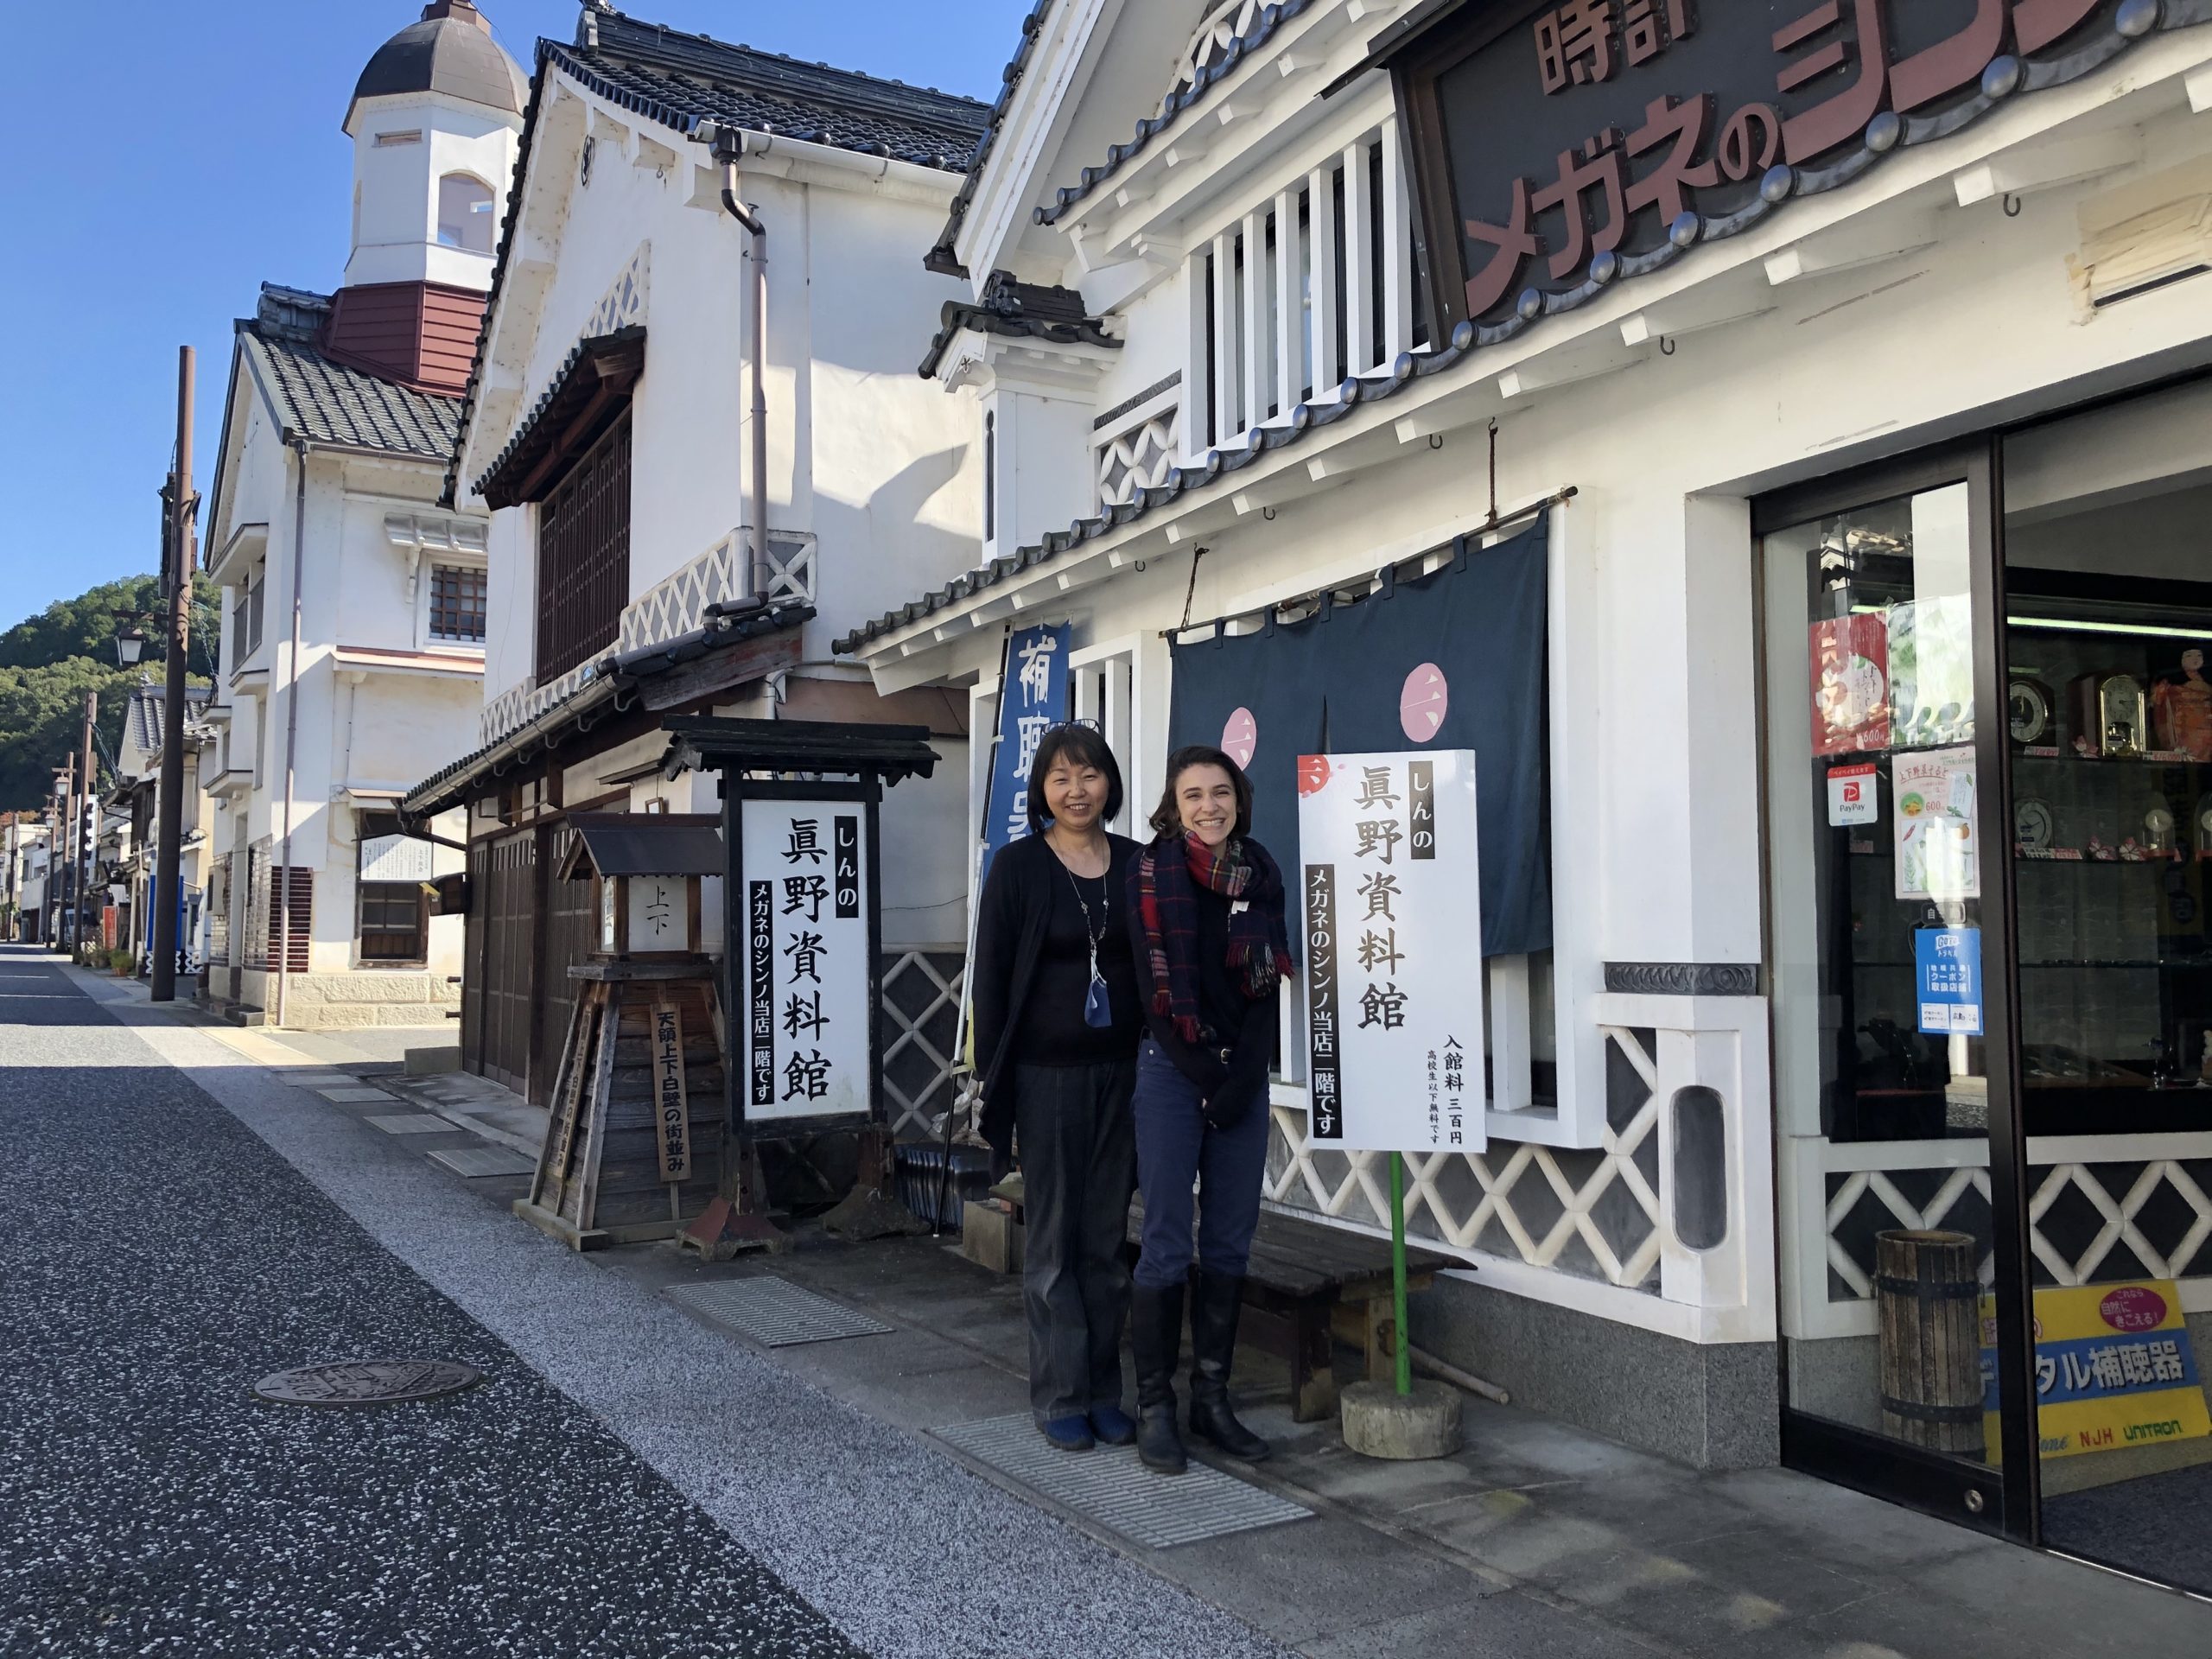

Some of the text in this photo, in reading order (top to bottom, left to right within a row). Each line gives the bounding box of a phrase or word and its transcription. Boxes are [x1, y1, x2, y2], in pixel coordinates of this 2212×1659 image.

[1411, 771, 1433, 849] しんの
[1839, 804, 1866, 812] PayPay
[837, 827, 857, 907] しんの
[1352, 766, 1408, 1032] 眞野資料館
[645, 885, 670, 936] 上下
[753, 884, 771, 1102] メガネのシンノ当店二階です
[780, 817, 833, 1102] 眞野資料館
[1930, 972, 1967, 982] クーポン
[1309, 867, 1337, 1135] メガネのシンノ当店二階です
[656, 1011, 685, 1173] 天領上下白壁の街並み
[2101, 1300, 2132, 1315] 自然に
[2079, 1427, 2114, 1448] NJH
